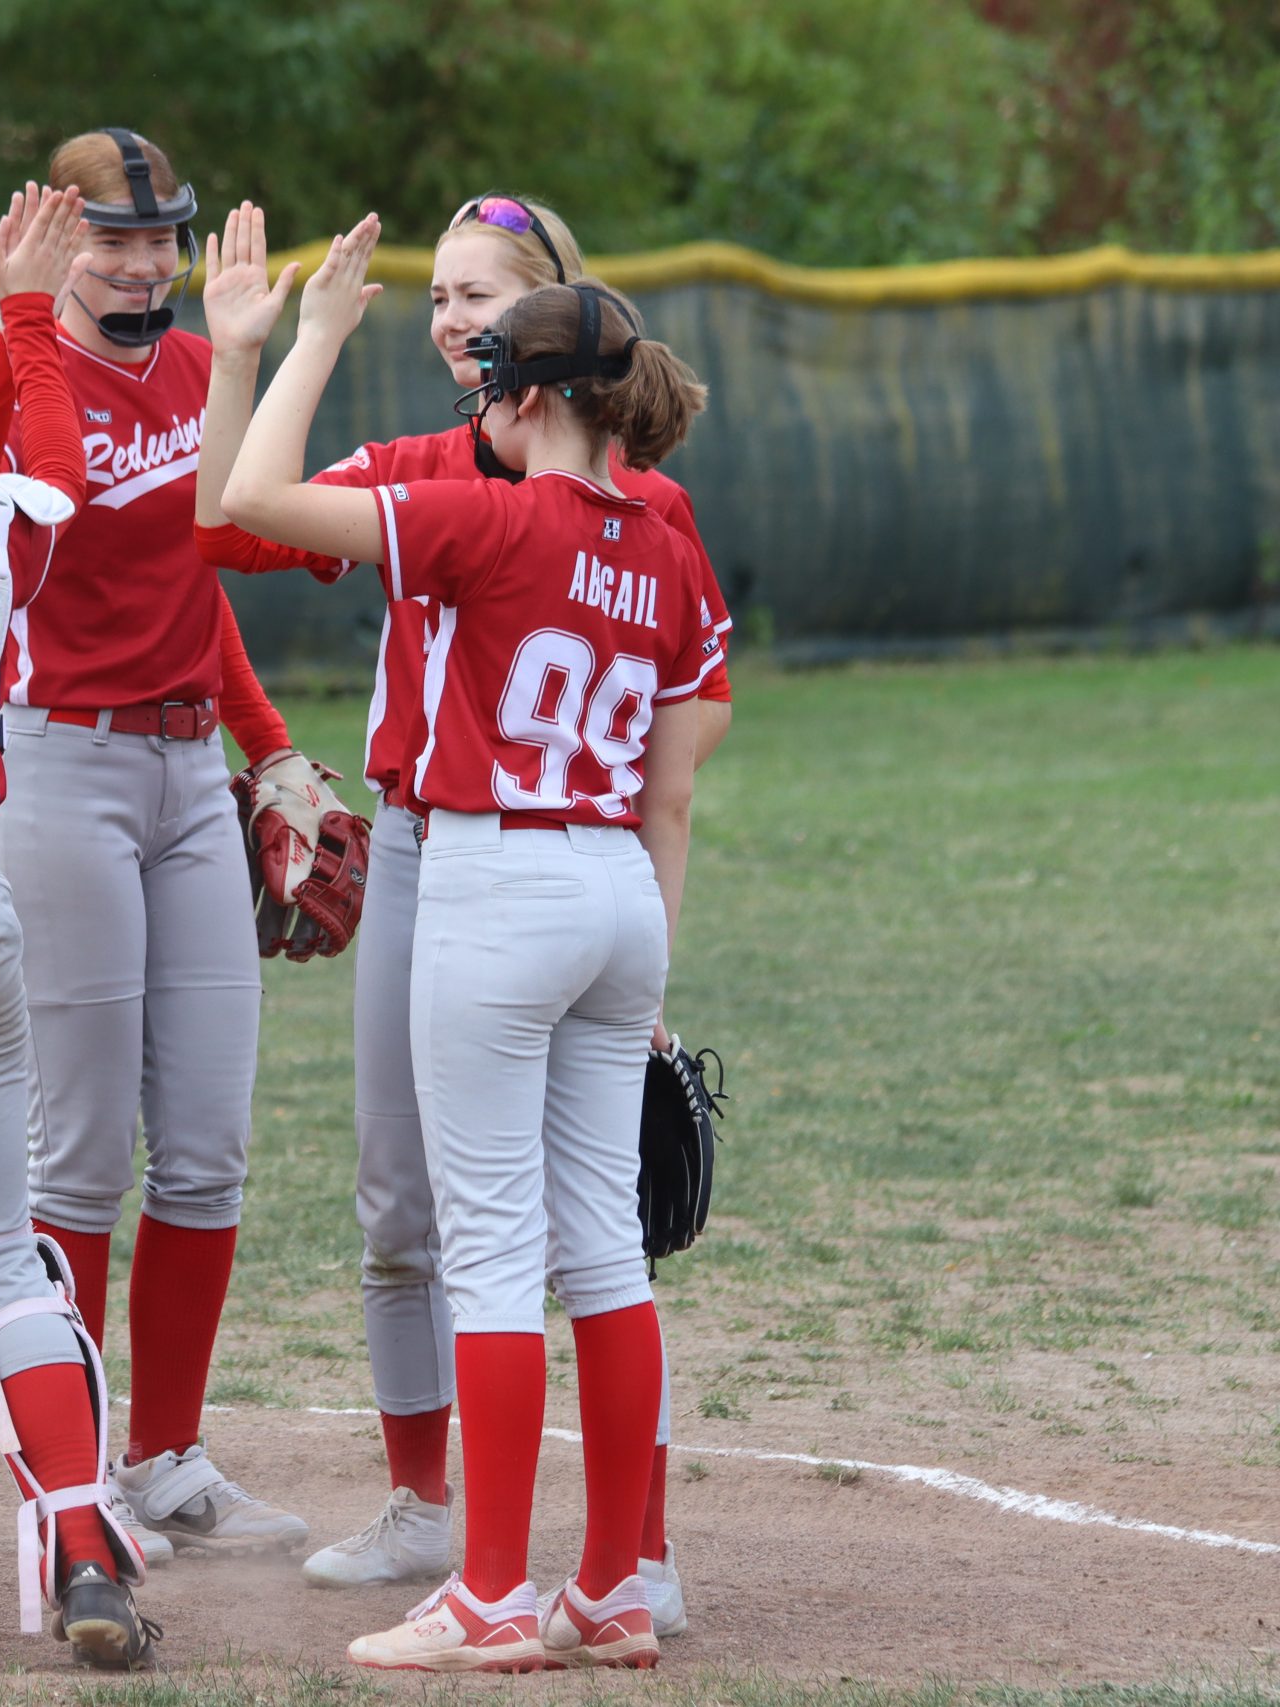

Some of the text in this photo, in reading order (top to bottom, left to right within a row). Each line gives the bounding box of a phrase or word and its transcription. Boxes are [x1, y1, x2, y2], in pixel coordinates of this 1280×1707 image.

[605, 520, 619, 530] TN
[604, 529, 619, 540] KD
[491, 627, 658, 818] 99
